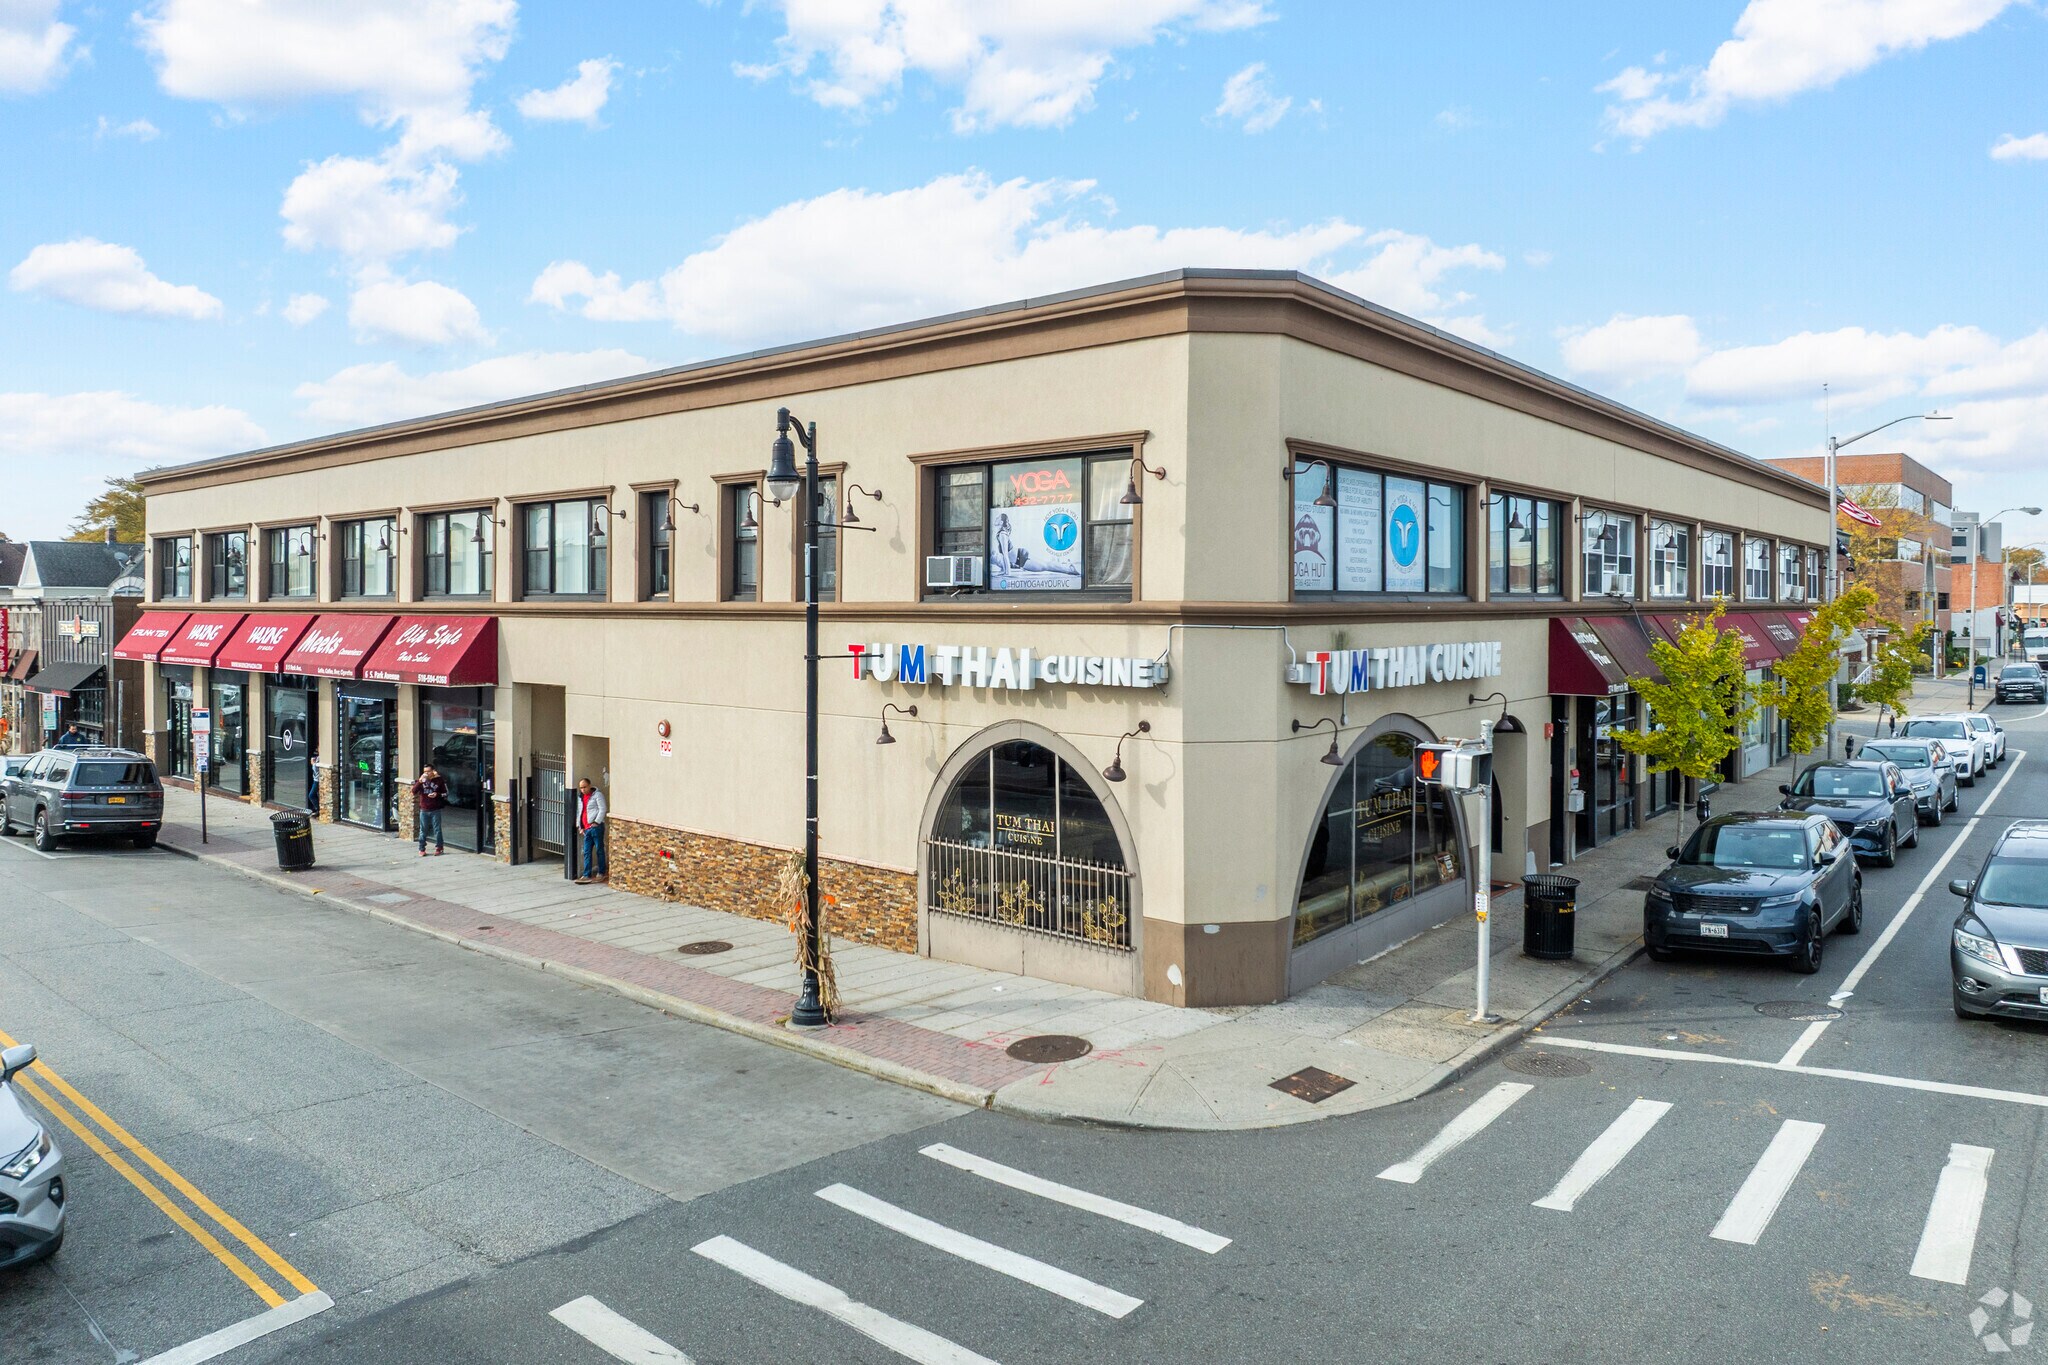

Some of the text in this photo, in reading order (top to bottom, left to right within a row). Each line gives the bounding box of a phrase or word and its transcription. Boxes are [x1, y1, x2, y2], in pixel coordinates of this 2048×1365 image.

[1010, 469, 1070, 494] YOGA
[1294, 562, 1327, 578] OGA HUT
[186, 624, 224, 641] WAXING
[246, 626, 288, 644] WAXING
[297, 629, 343, 654] Meeks
[395, 624, 463, 650] Clip Style
[848, 642, 1154, 690] TUM THAI CUISINE
[1309, 641, 1502, 695] TUM THAI CUISINE
[369, 671, 374, 679] S.
[374, 671, 384, 680] Park
[384, 672, 400, 681] Avenue
[661, 741, 672, 752] FDC
[1357, 787, 1412, 820] TUM THAI
[996, 814, 1054, 832] TUM THAI
[1368, 820, 1401, 841] CUISINE
[1008, 832, 1042, 846] CUISINE
